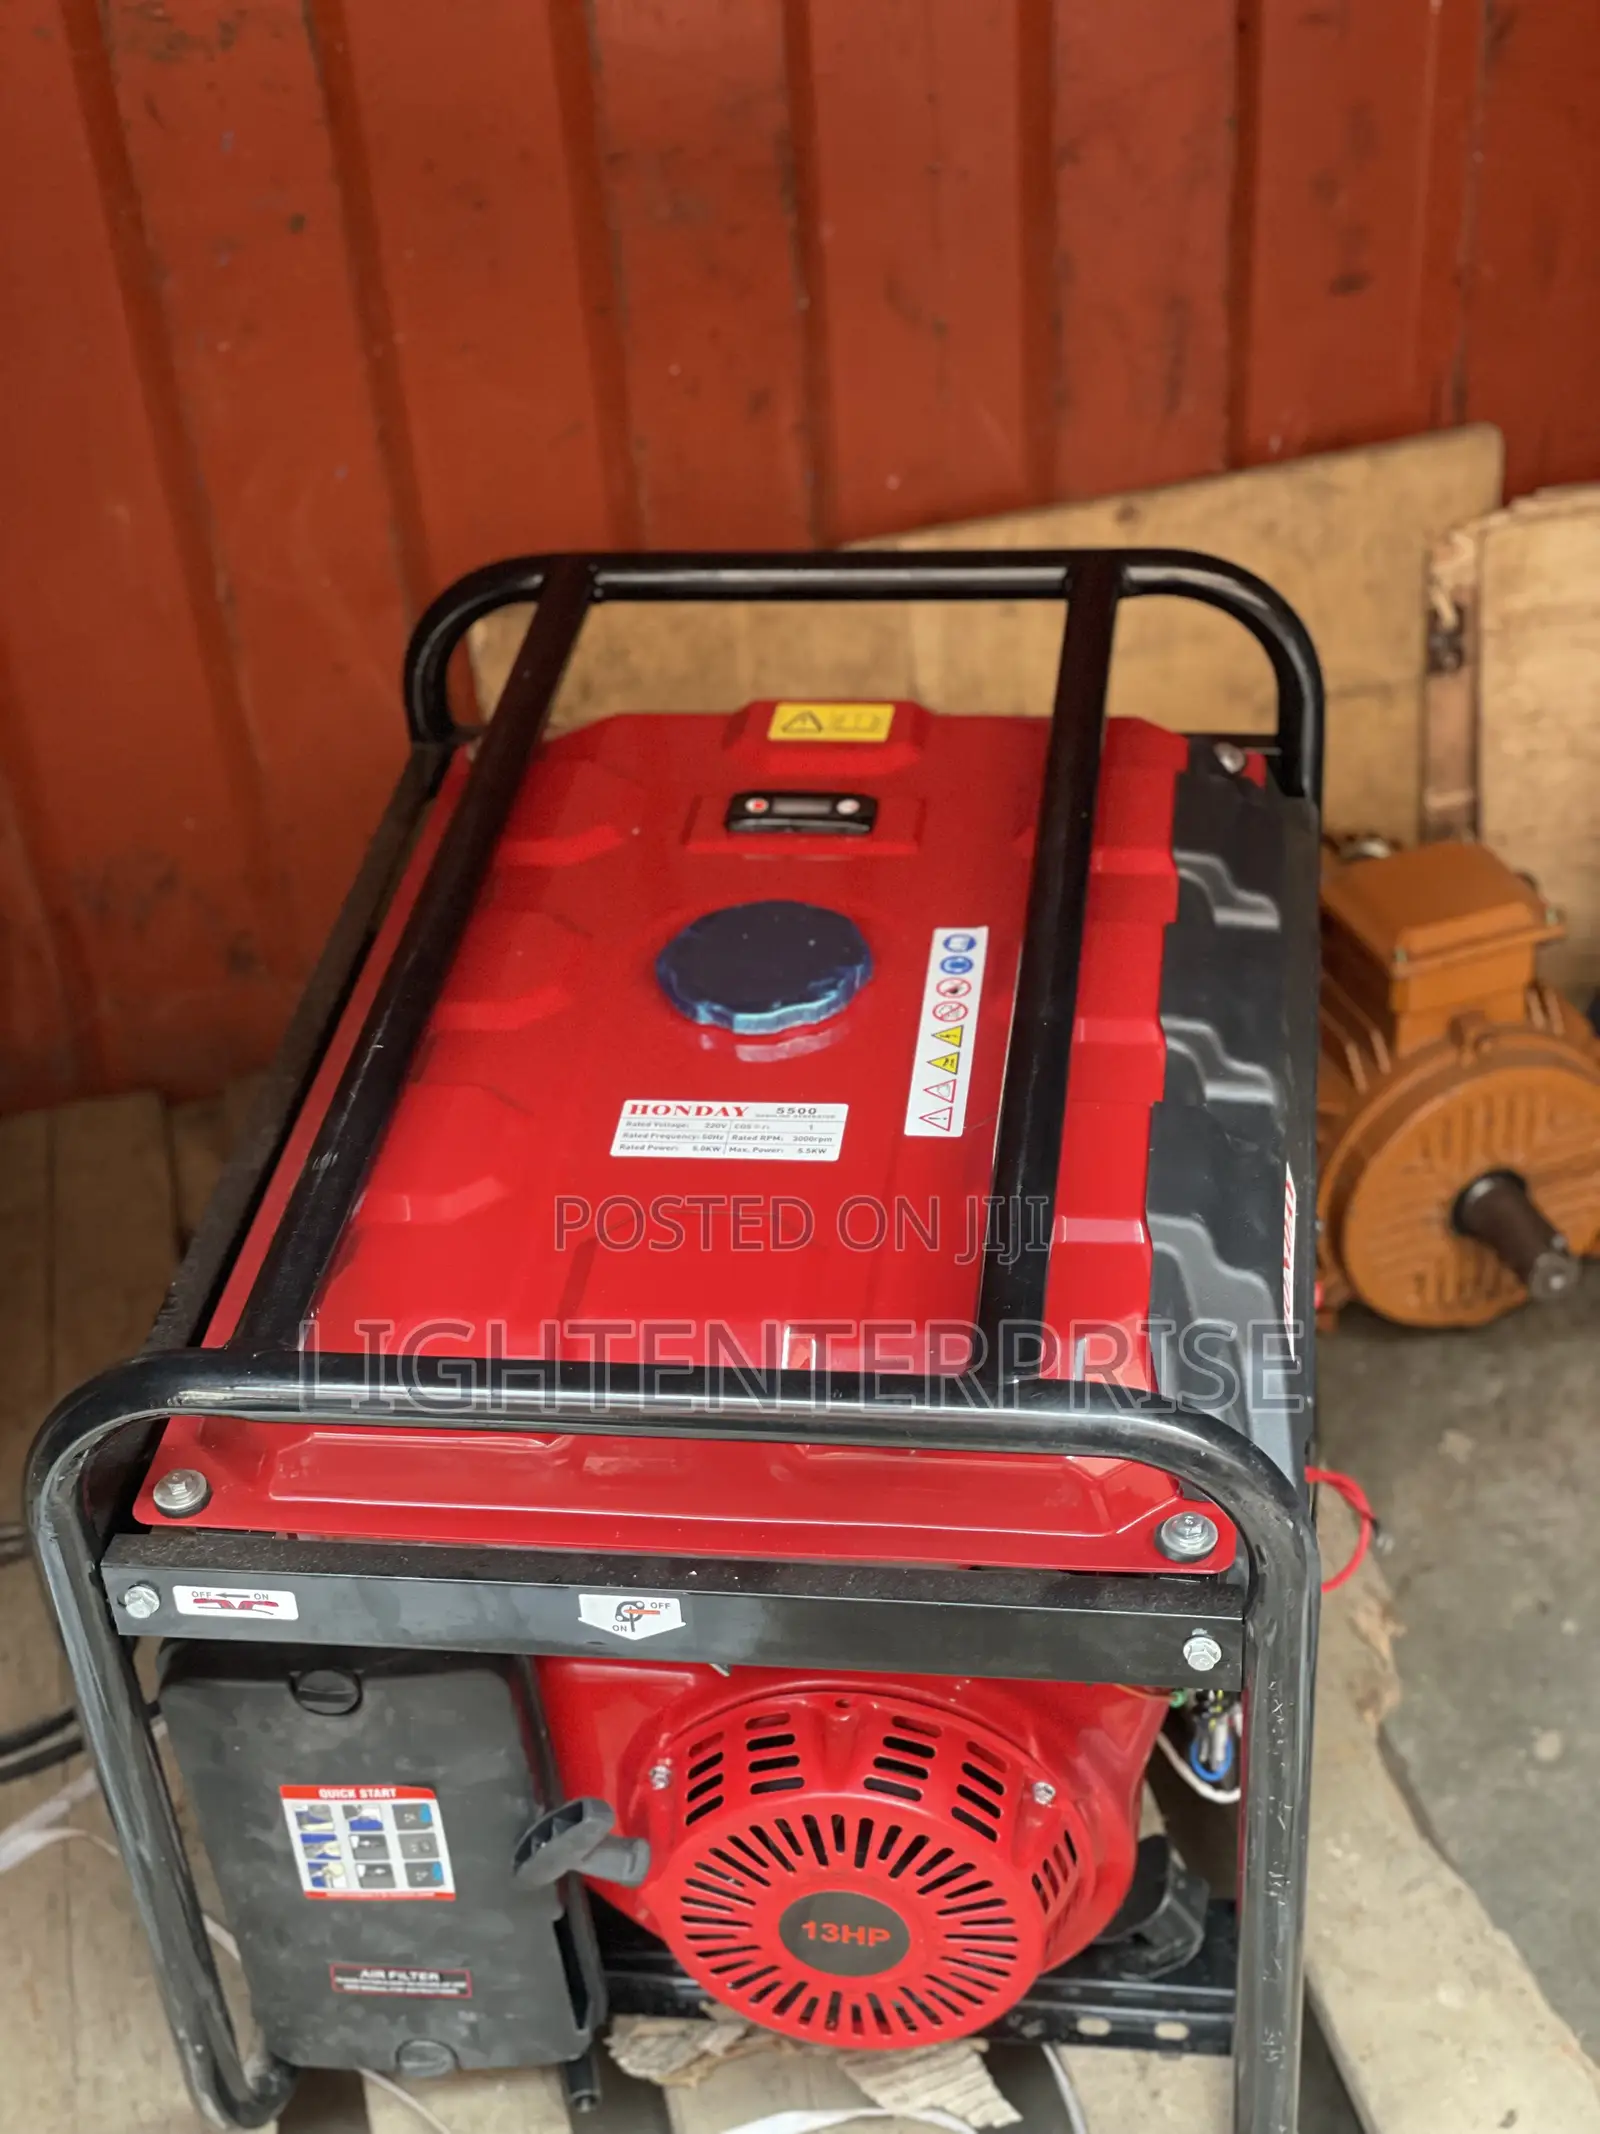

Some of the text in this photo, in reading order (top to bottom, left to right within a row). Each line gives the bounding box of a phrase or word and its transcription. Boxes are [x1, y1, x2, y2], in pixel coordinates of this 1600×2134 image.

[628, 1104, 749, 1117] HONDAY
[776, 1107, 817, 1115] 5500
[653, 1121, 690, 1129] Voltage:
[650, 1132, 700, 1141] Frequency:
[752, 1146, 784, 1154] Power:
[191, 1590, 212, 1599] OFF
[253, 1592, 270, 1601] ON
[650, 1601, 671, 1610] OFF
[612, 1624, 628, 1632] ON
[318, 1787, 397, 1799] QUICK START
[801, 1920, 891, 1948] 13HP
[359, 1968, 441, 1981] AIR FILTER
